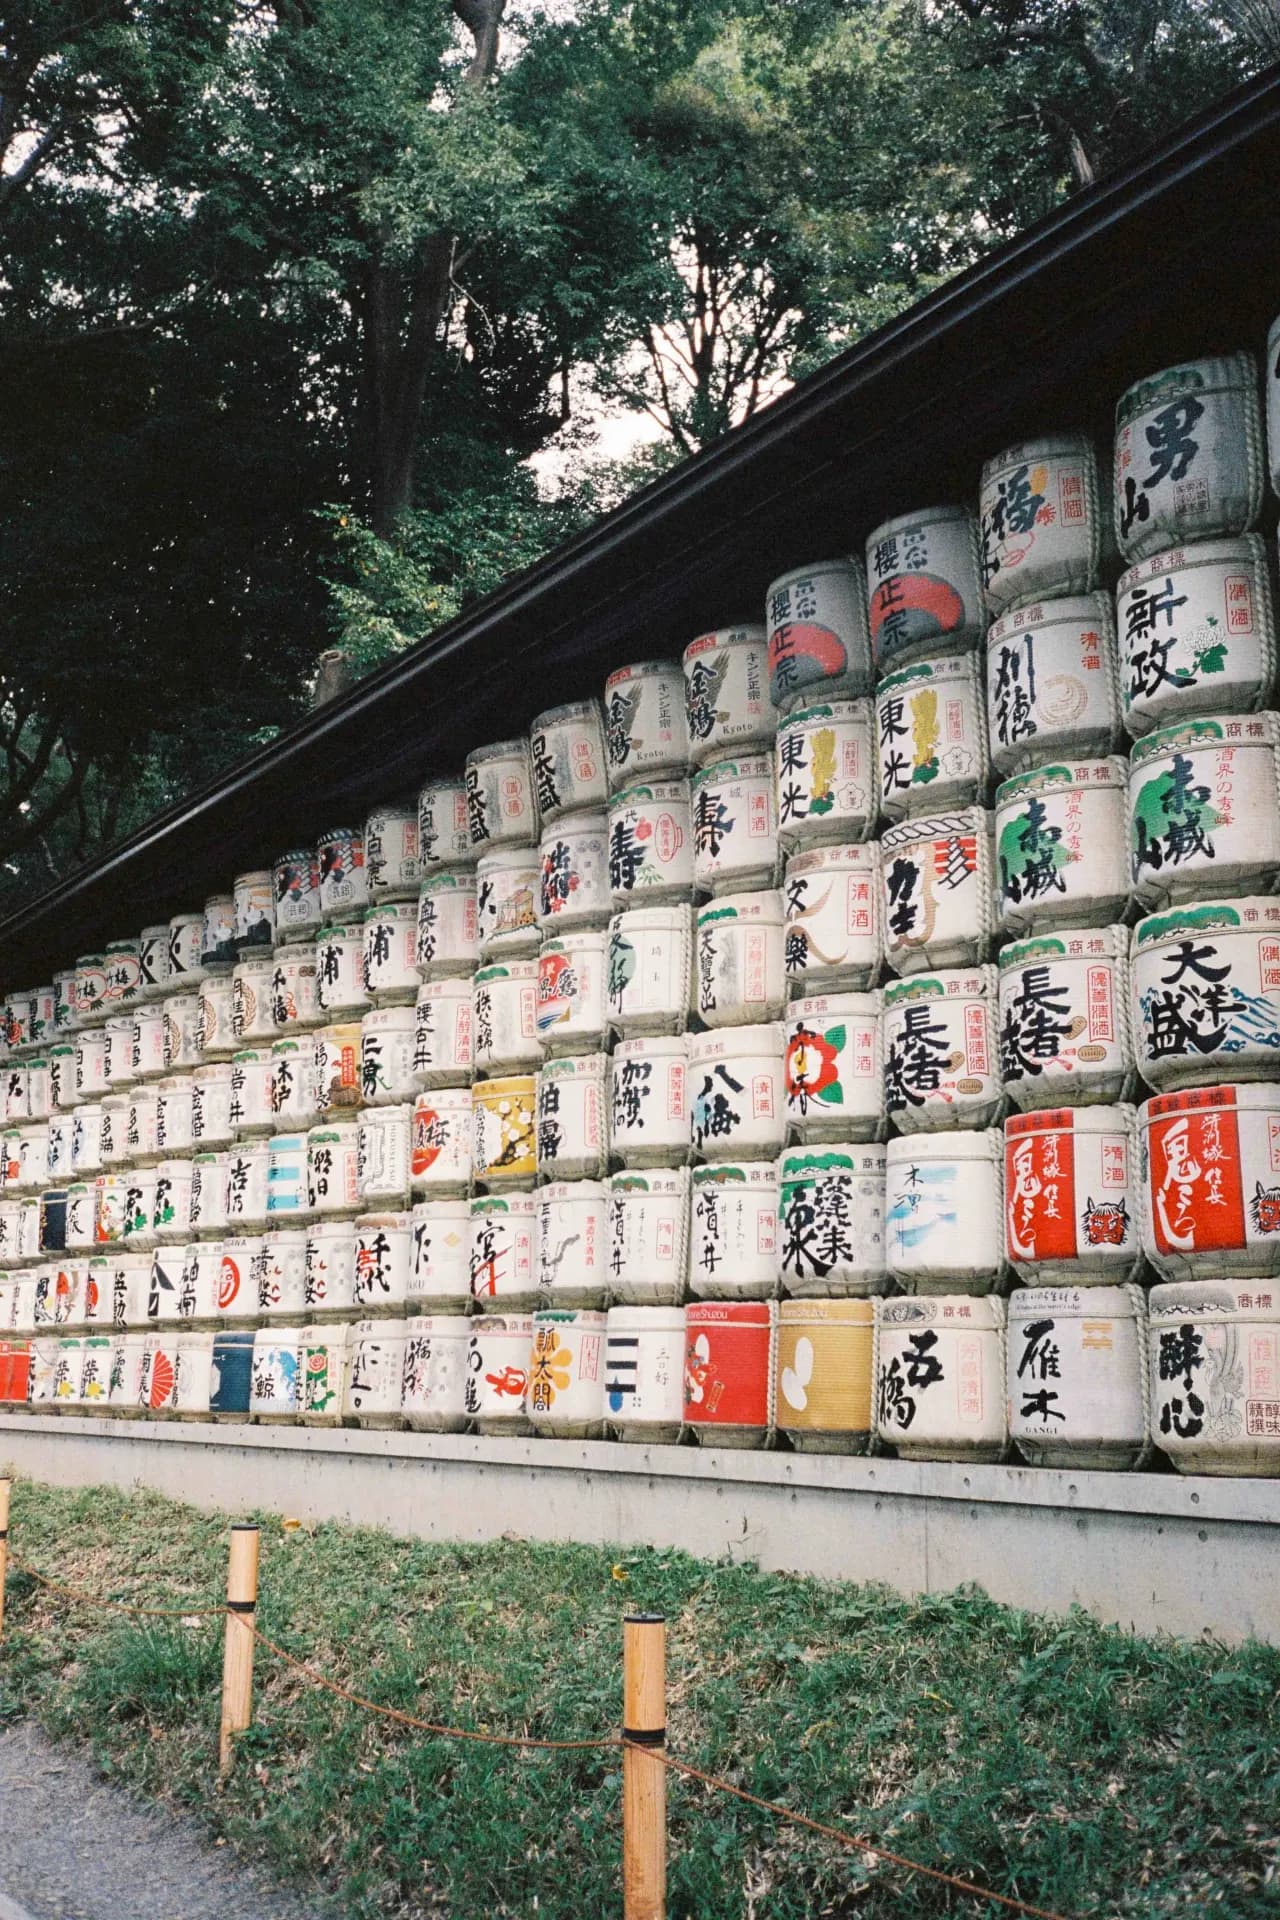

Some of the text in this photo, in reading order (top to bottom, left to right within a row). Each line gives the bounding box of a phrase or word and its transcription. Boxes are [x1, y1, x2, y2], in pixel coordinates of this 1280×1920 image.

[1120, 397, 1205, 538] 男山
[1063, 476, 1082, 519] 清酒
[1228, 582, 1249, 626] 清酒
[1080, 631, 1100, 671] 清酒
[1125, 577, 1197, 700] 新政
[722, 723, 753, 734] Kyoto
[879, 697, 913, 797] 東光
[1225, 722, 1264, 737] 商標
[636, 750, 664, 761] Kyoto
[1074, 766, 1111, 781] 商標
[779, 732, 808, 825] 東光
[752, 796, 766, 832] 清酒
[852, 882, 869, 928] 清酒
[1068, 939, 1105, 953] 商標
[947, 979, 981, 994] 商標
[1147, 941, 1247, 1060] 大洋盛
[412, 1002, 435, 1072] 腰古井
[1000, 966, 1074, 1083] 長者盛
[856, 1032, 871, 1072] 清酒
[884, 1004, 953, 1112] 長者盛
[691, 1064, 745, 1151] 八海山
[756, 1082, 770, 1112] 清酒
[750, 1170, 777, 1182] 商標
[1103, 1145, 1125, 1182] 清酒
[652, 1180, 676, 1192] 商標
[659, 1221, 672, 1254] 清酒
[759, 1215, 774, 1250] 清酒
[943, 1305, 972, 1318] 商標
[1238, 1293, 1272, 1309] 商標
[1017, 1318, 1067, 1423] 雁木
